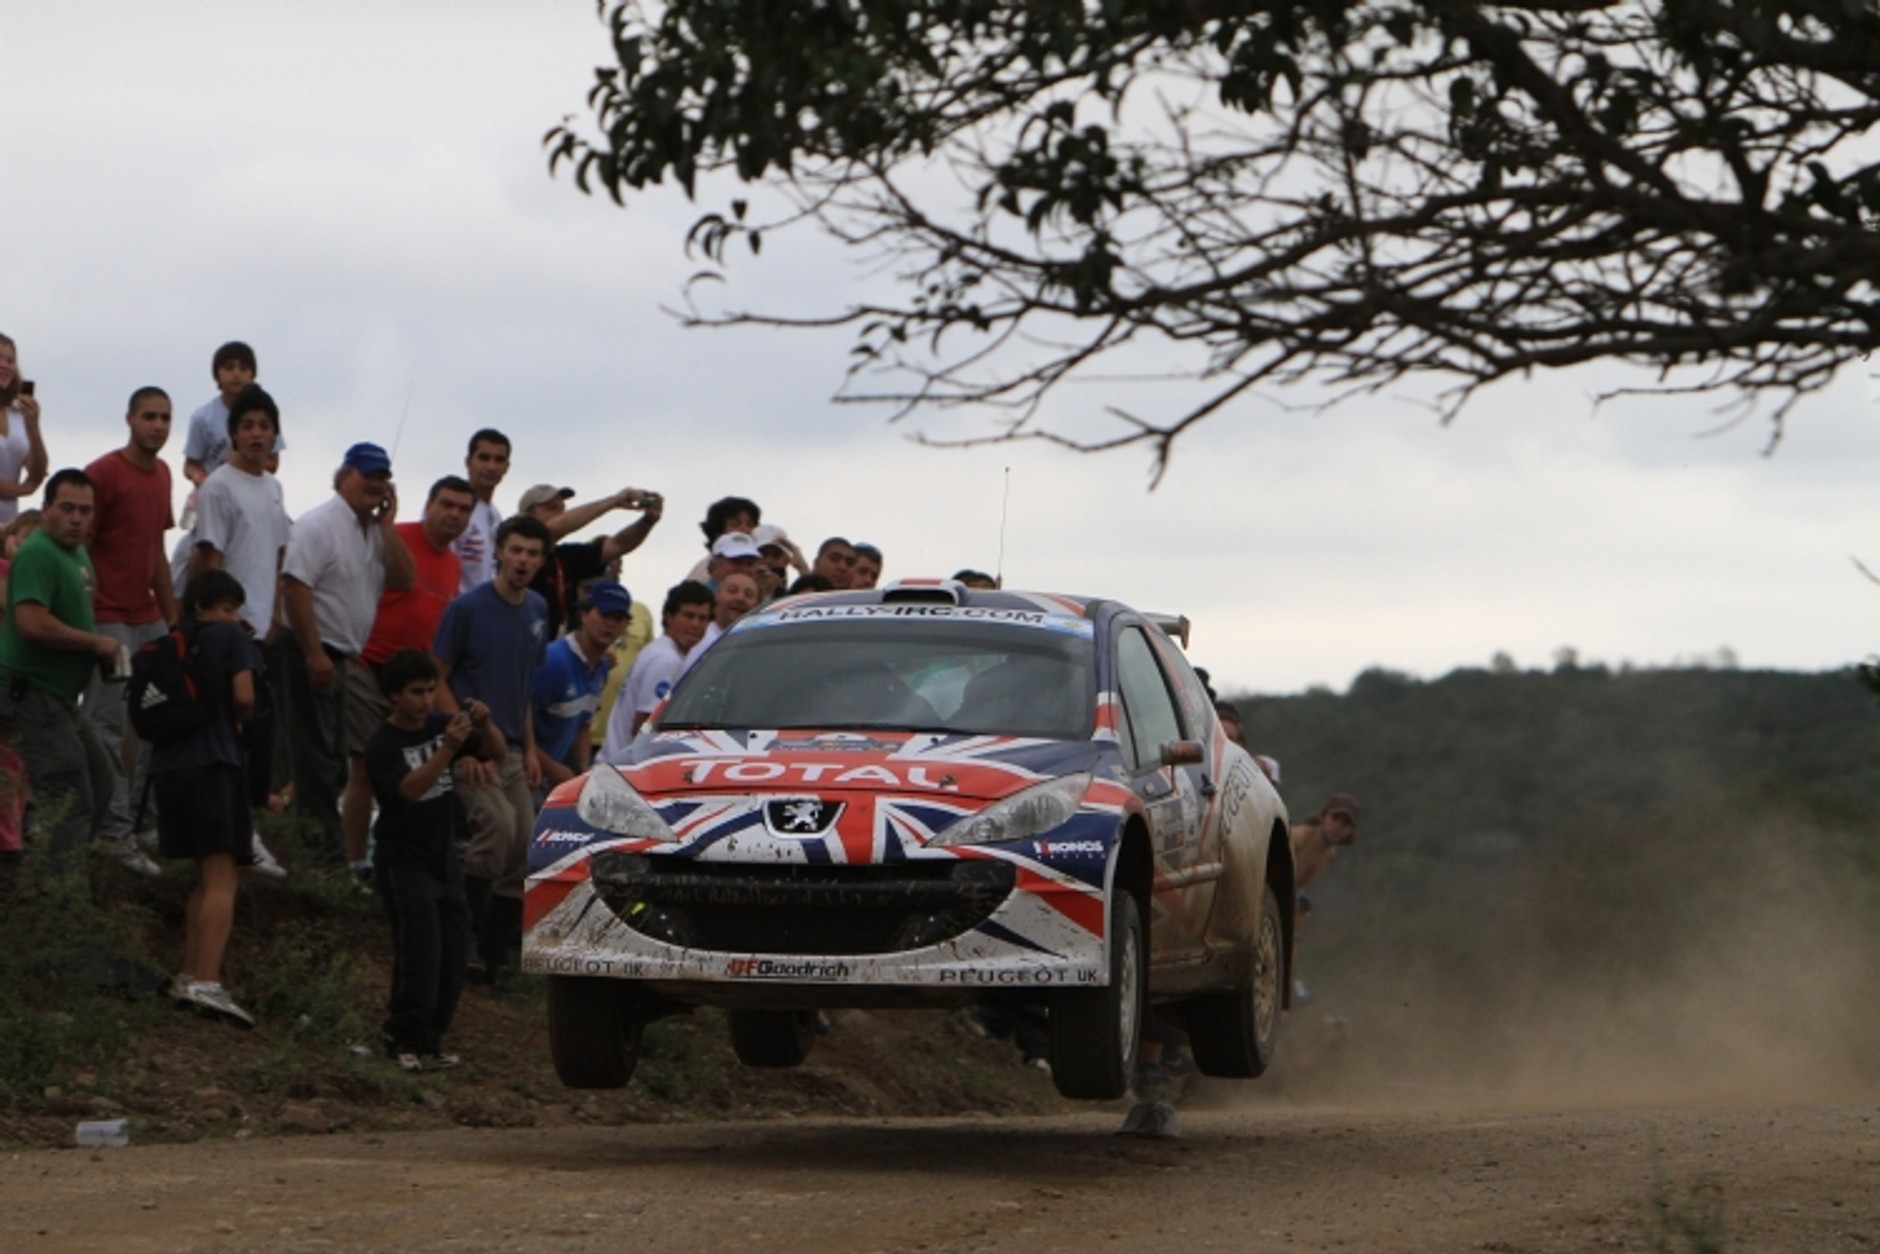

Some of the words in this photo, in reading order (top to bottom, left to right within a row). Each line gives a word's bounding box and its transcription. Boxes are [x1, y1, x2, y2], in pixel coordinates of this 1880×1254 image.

[778, 604, 1046, 624] RALLY-IRC.COM
[681, 758, 958, 792] TOTAL
[939, 968, 1069, 983] PEUGEOT
[1077, 969, 1097, 983] UK
